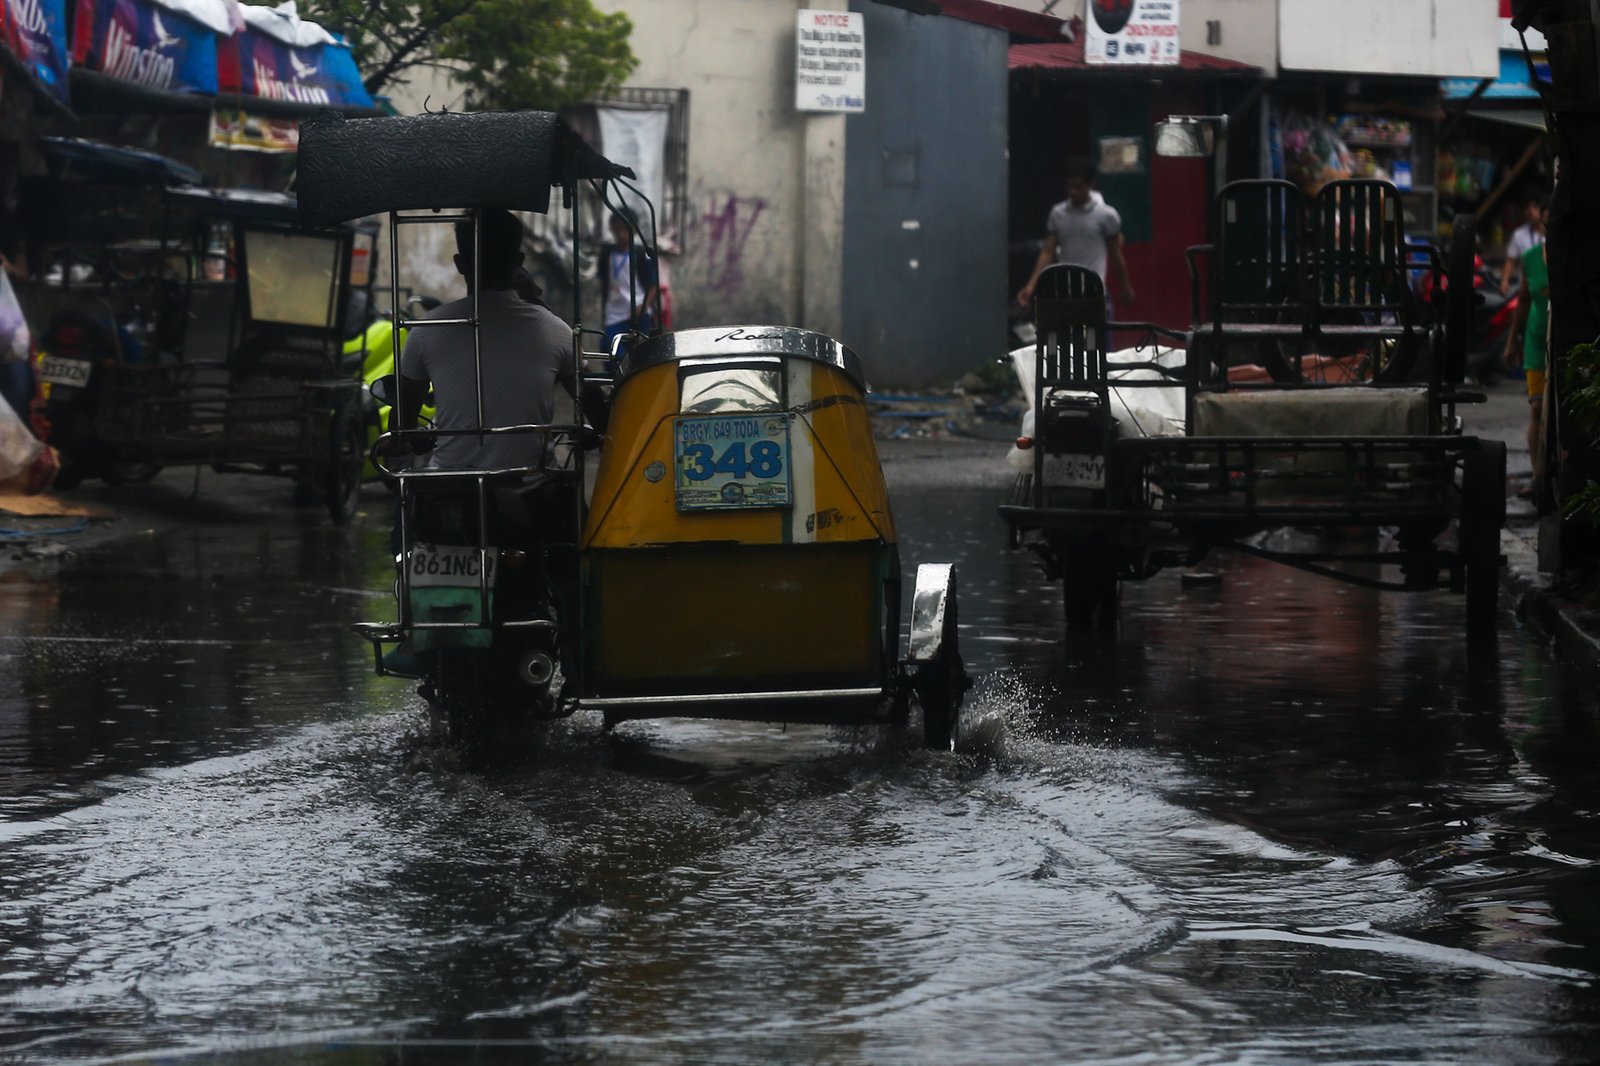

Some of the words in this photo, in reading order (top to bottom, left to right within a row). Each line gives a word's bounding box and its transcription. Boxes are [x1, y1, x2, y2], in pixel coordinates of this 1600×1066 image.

[814, 14, 849, 27] NOTICE
[104, 18, 175, 91] Winston
[253, 57, 329, 105] Winston
[683, 422, 711, 441] BRGY.
[714, 422, 731, 440] 649
[733, 420, 760, 439] TODA
[683, 440, 783, 481] 348
